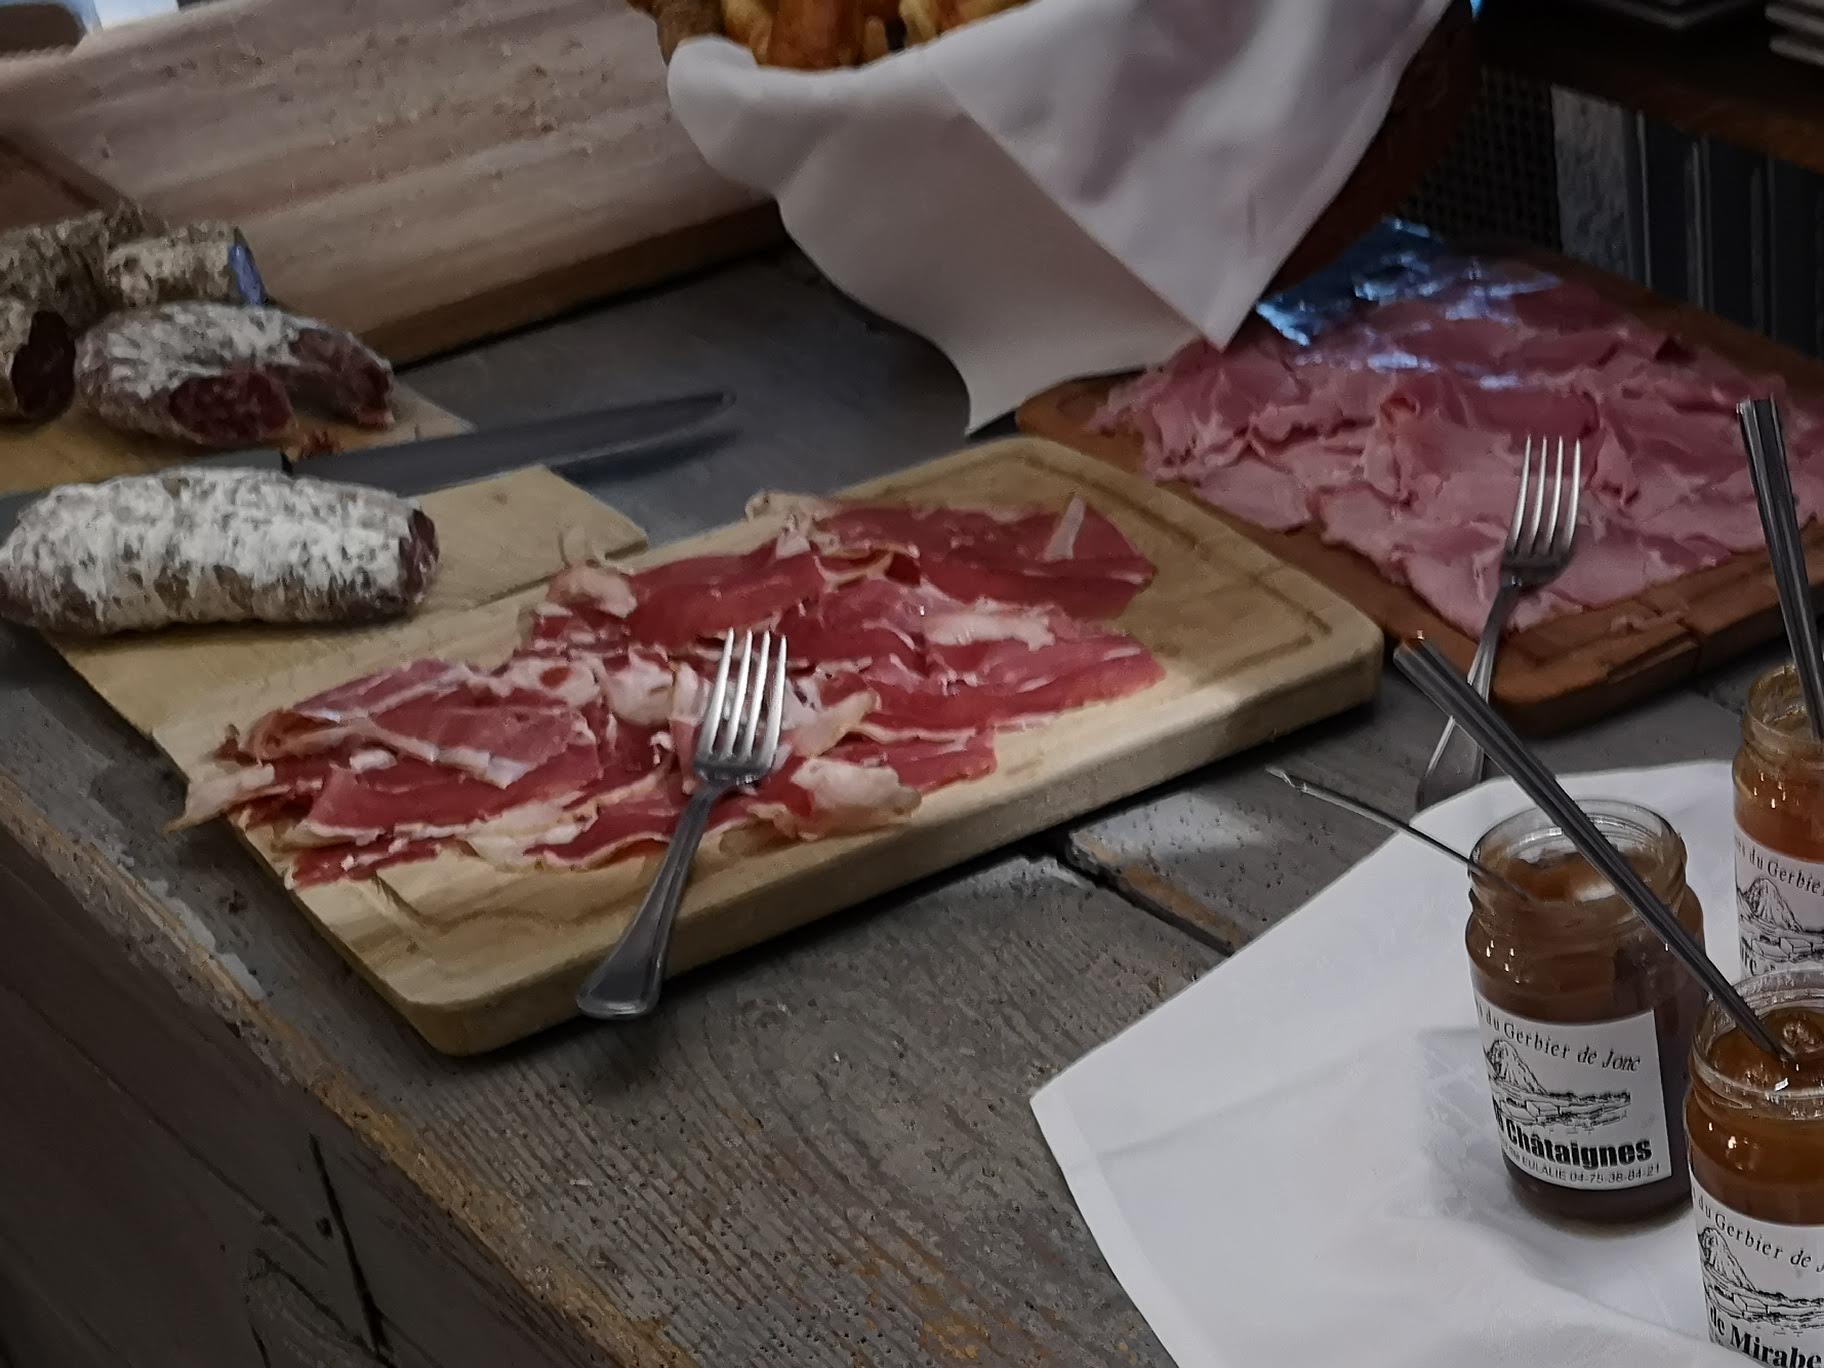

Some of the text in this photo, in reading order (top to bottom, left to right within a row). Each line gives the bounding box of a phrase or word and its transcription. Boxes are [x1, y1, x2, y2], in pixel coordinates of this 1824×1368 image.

[1486, 1010, 1499, 1031] du
[1504, 1022, 1570, 1060] Gerbier
[1577, 1045, 1598, 1065] de
[1602, 1048, 1640, 1073] Jonc
[1507, 1118, 1653, 1170] Châtaignes
[1698, 1194, 1711, 1218] du
[1714, 1213, 1783, 1260] Gerbier
[1790, 1250, 1811, 1270] de
[1710, 1304, 1725, 1336] de
